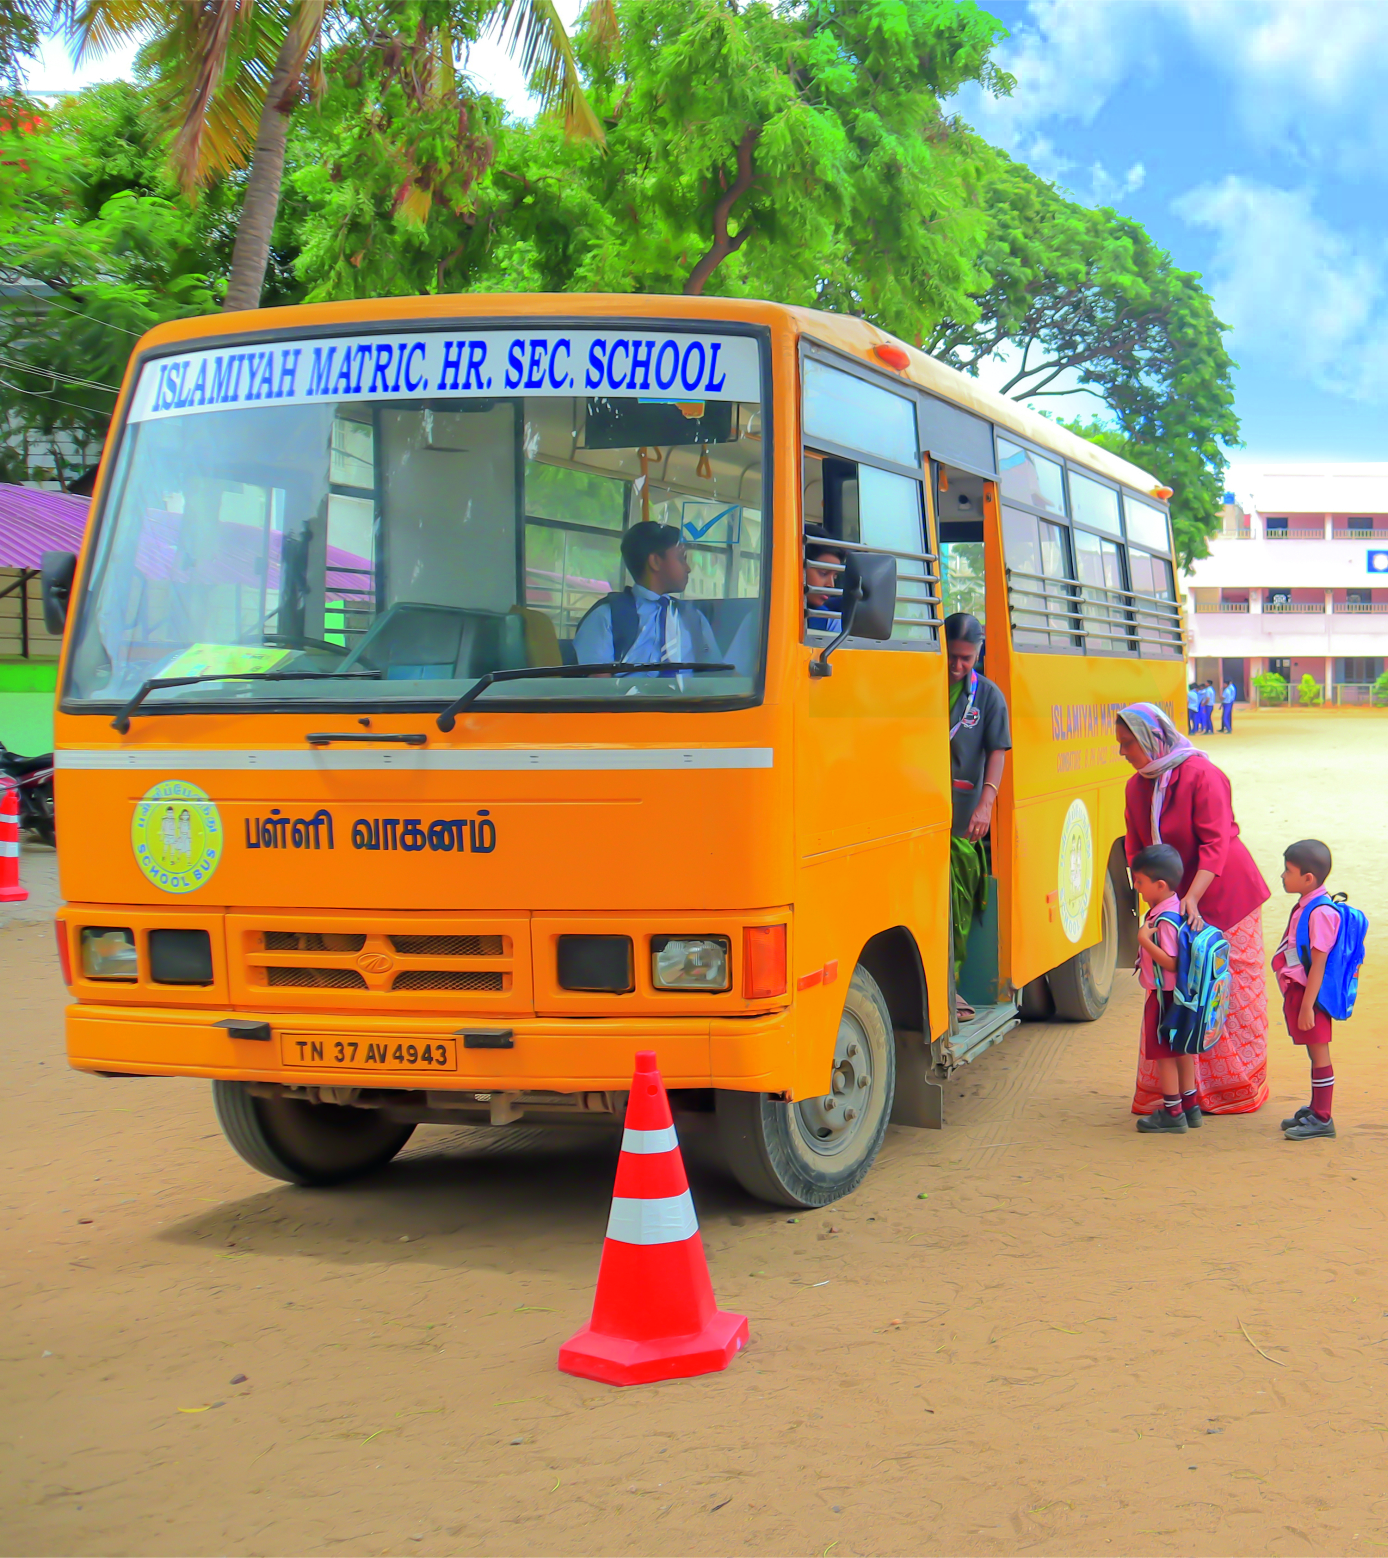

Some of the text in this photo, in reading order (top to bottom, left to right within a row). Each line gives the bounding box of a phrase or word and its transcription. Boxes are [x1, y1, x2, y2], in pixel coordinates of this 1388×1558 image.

[151, 338, 726, 412] ISLAMIYAH MATRIC. HR. SEC. SCHOOL
[1051, 703, 1098, 741] ISLAMIYAH
[244, 809, 496, 853] பள்ளி வாகனம்
[137, 844, 216, 887] SCHOOL BUS
[296, 1041, 447, 1066] TN 37 AV 4943
